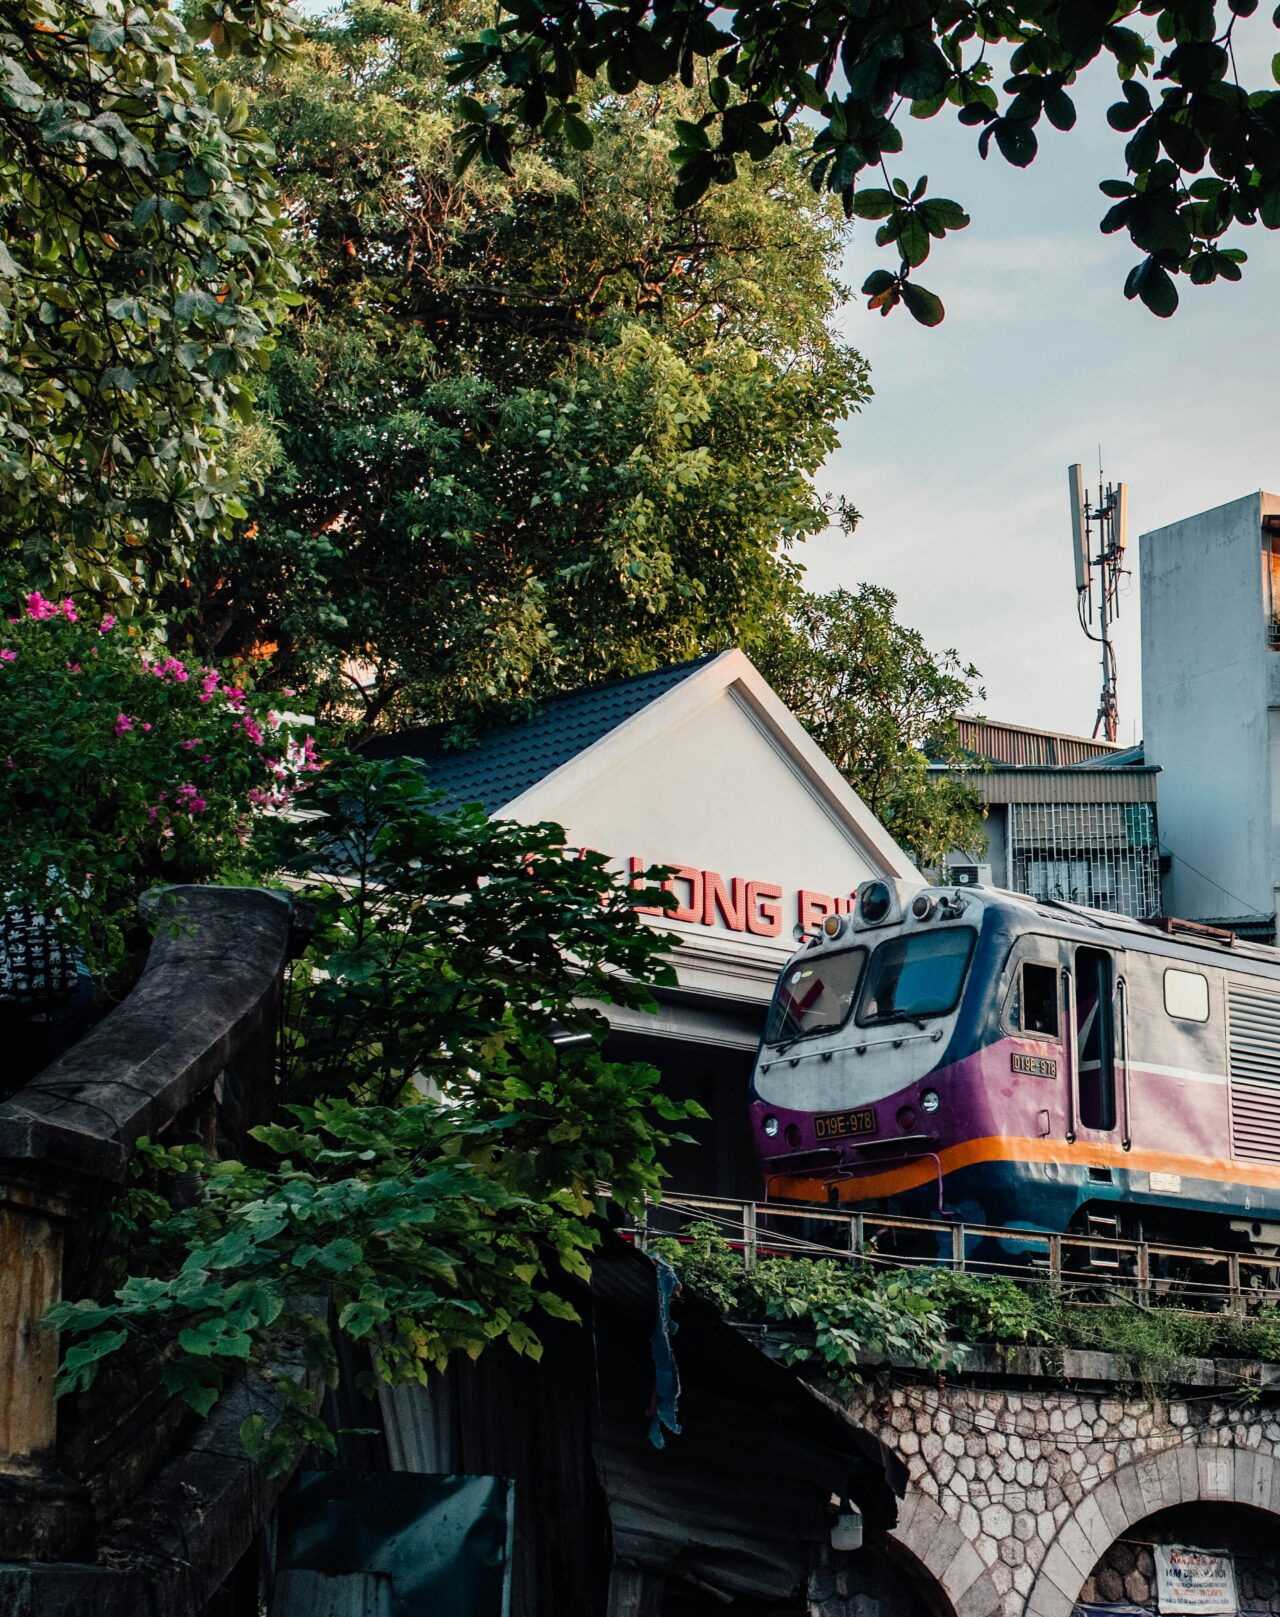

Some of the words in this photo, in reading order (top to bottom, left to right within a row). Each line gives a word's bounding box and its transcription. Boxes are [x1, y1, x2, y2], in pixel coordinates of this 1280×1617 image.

[630, 856, 783, 937] LONG
[1013, 1055, 1056, 1075] D19E-978
[815, 1112, 872, 1137] D19E-978
